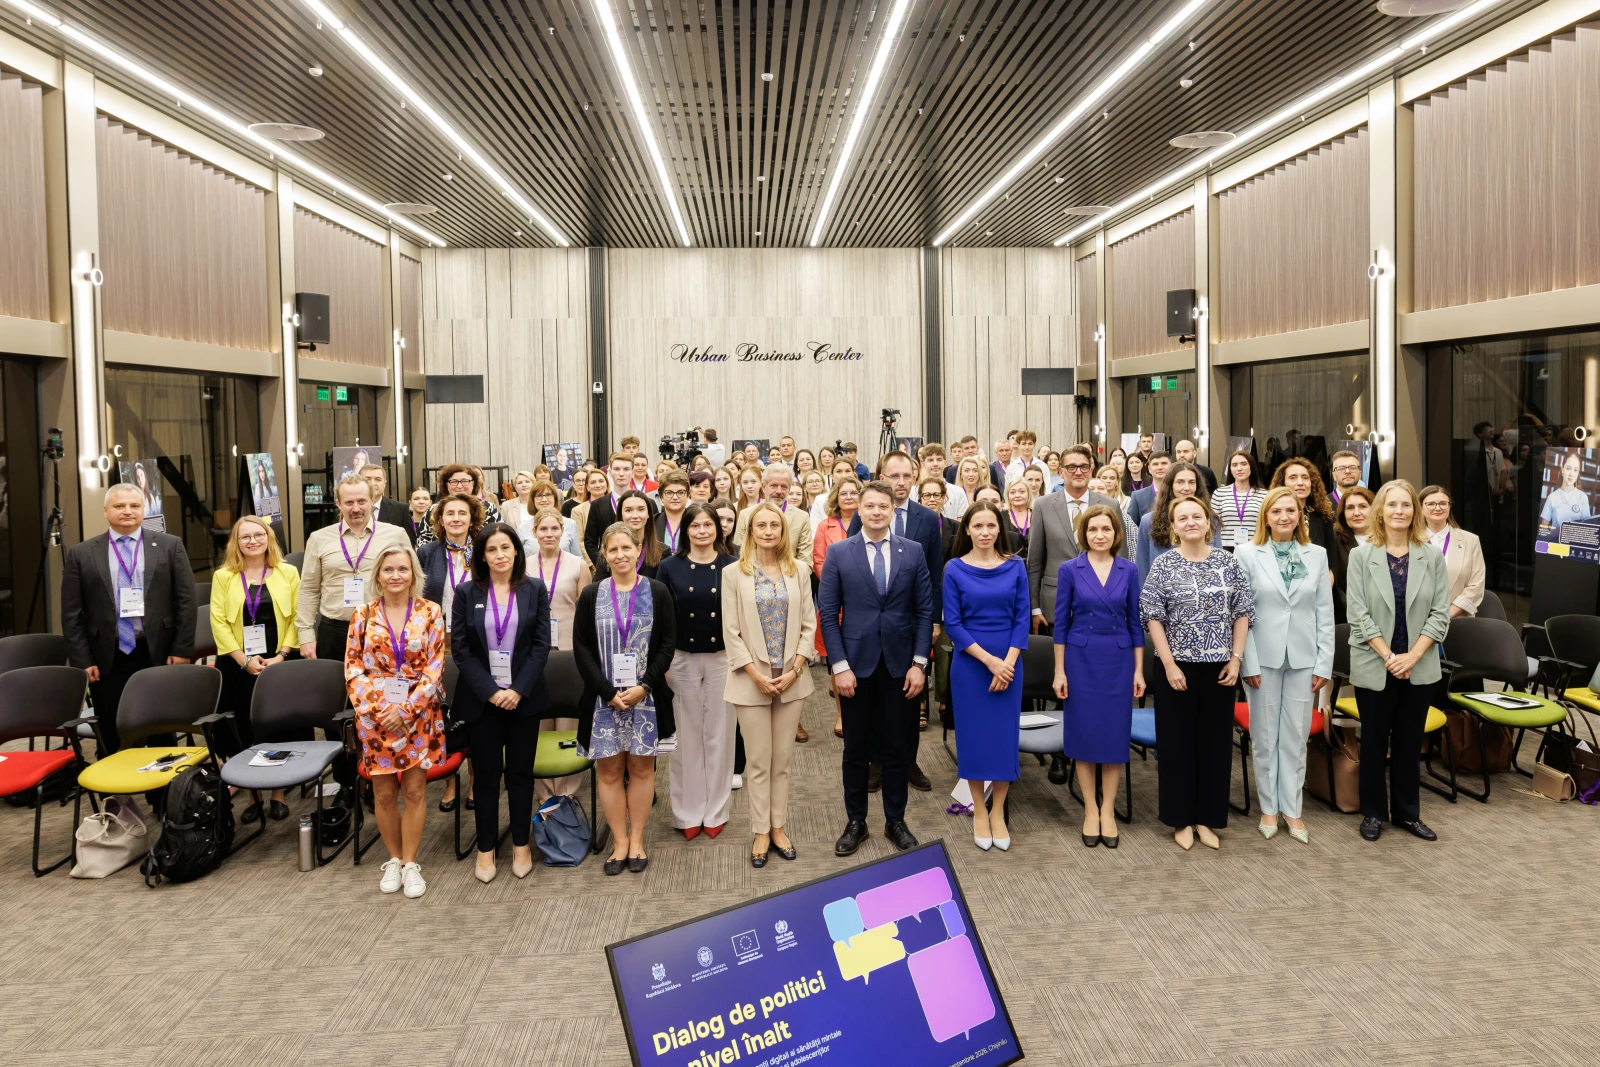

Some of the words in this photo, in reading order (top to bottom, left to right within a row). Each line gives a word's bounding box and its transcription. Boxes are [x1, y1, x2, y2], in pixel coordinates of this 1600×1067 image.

[670, 343, 729, 363] Urban
[736, 342, 805, 362] Business
[806, 341, 864, 364] Center
[652, 1015, 725, 1056] Dialog
[729, 1003, 756, 1026] de
[760, 970, 826, 1019] politici
[741, 1020, 792, 1055] înalt
[822, 1030, 842, 1044] mintale
